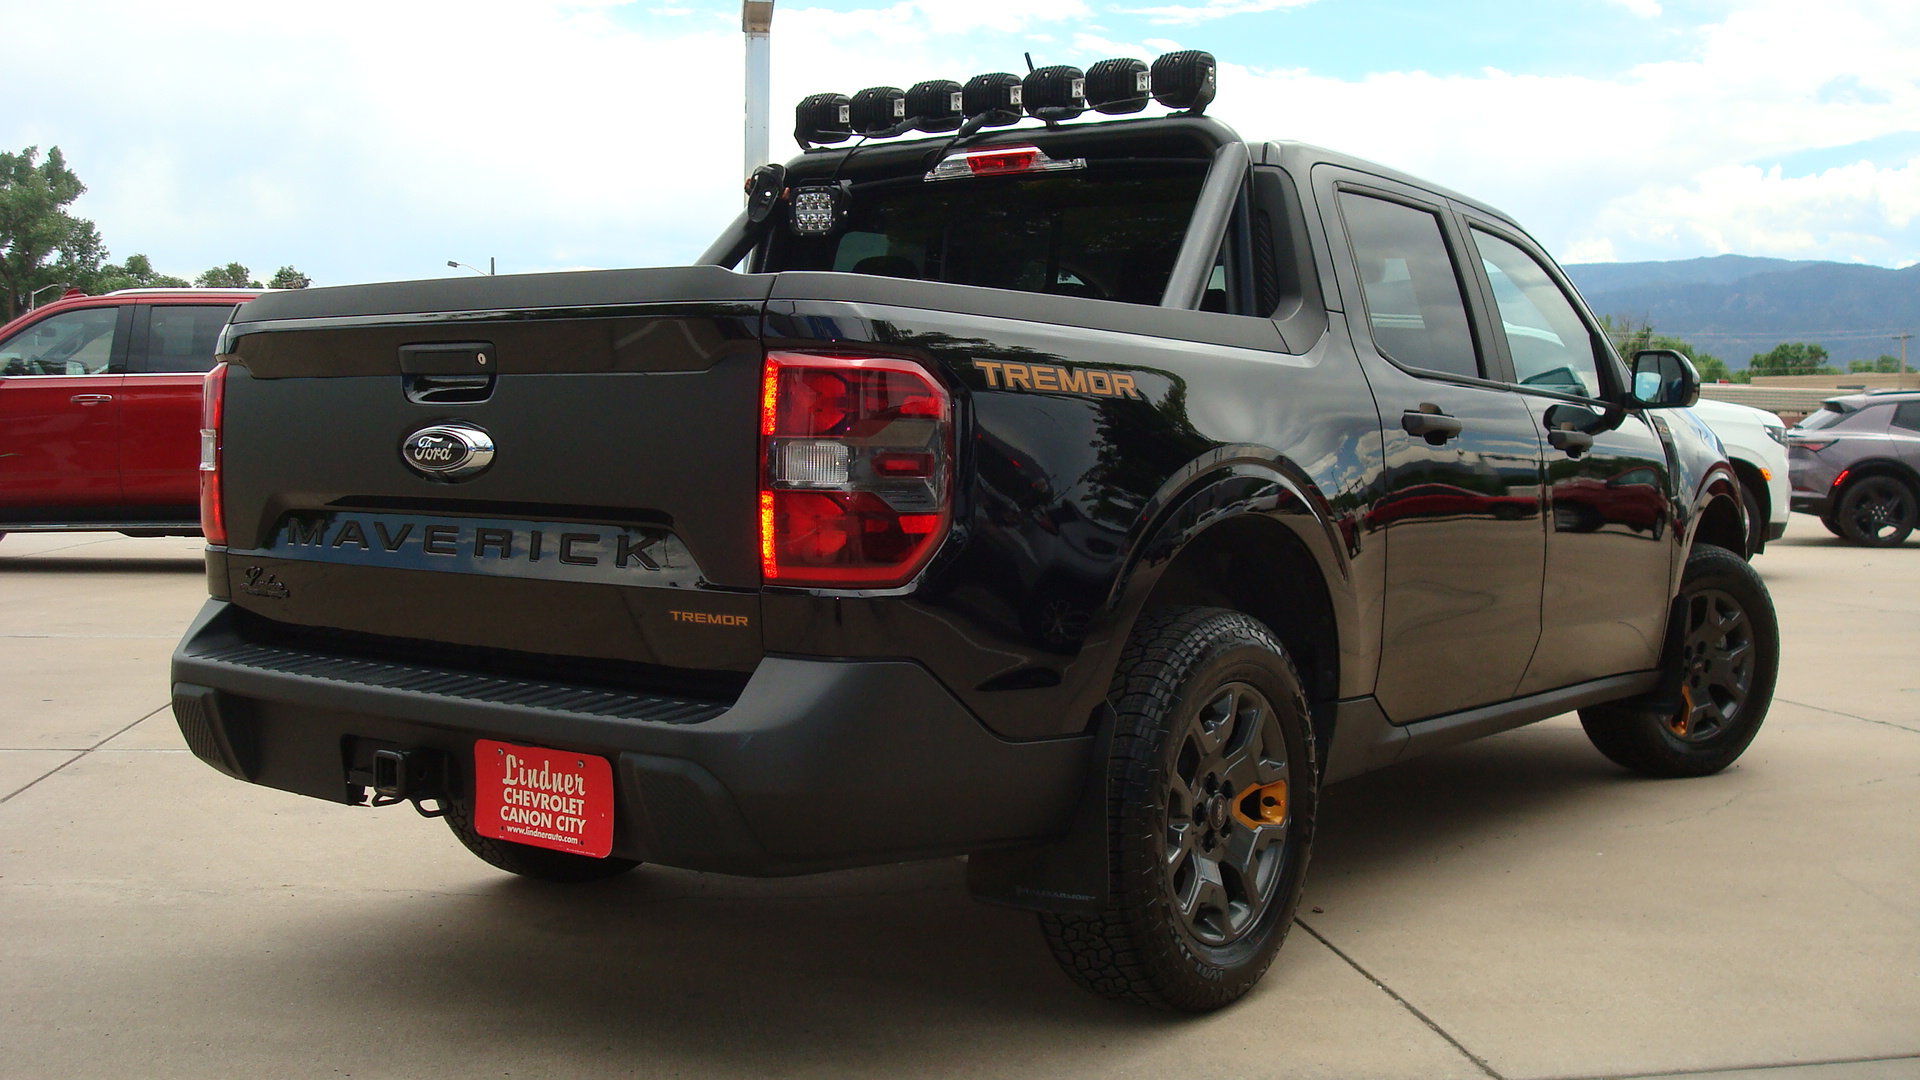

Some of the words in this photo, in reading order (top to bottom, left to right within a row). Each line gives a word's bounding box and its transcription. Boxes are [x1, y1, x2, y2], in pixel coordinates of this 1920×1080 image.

[973, 359, 1139, 399] TREMOR
[414, 436, 453, 461] Ford
[287, 517, 660, 571] MAVERICK
[670, 610, 748, 626] TREMOR
[502, 754, 586, 796] Lindner
[503, 787, 585, 816] CHEVROLET
[500, 805, 552, 828] CANON
[556, 815, 586, 834] CITY
[506, 825, 578, 845] www.lindnerauto.com
